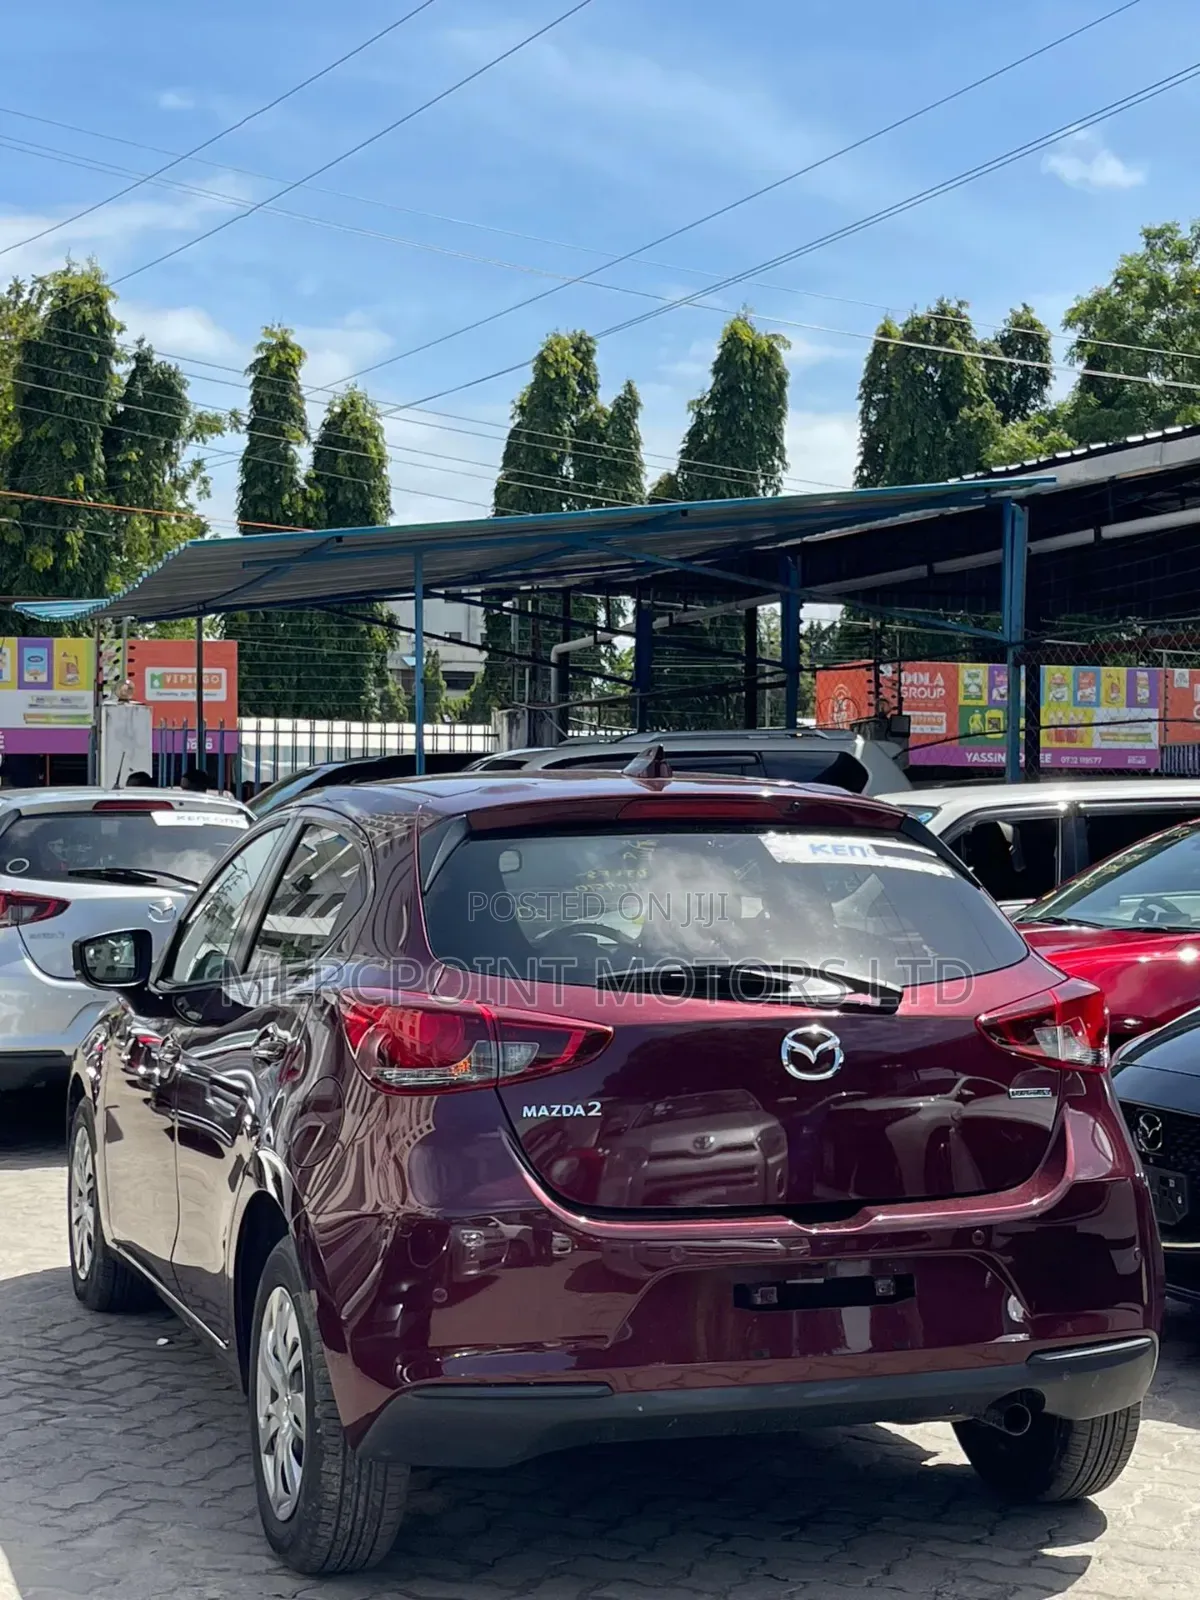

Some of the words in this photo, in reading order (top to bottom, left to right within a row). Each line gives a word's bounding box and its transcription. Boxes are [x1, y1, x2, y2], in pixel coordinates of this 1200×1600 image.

[165, 674, 220, 684] VIPIGO
[965, 752, 1006, 763] YASSIN
[522, 1101, 602, 1118] MAZDA2
